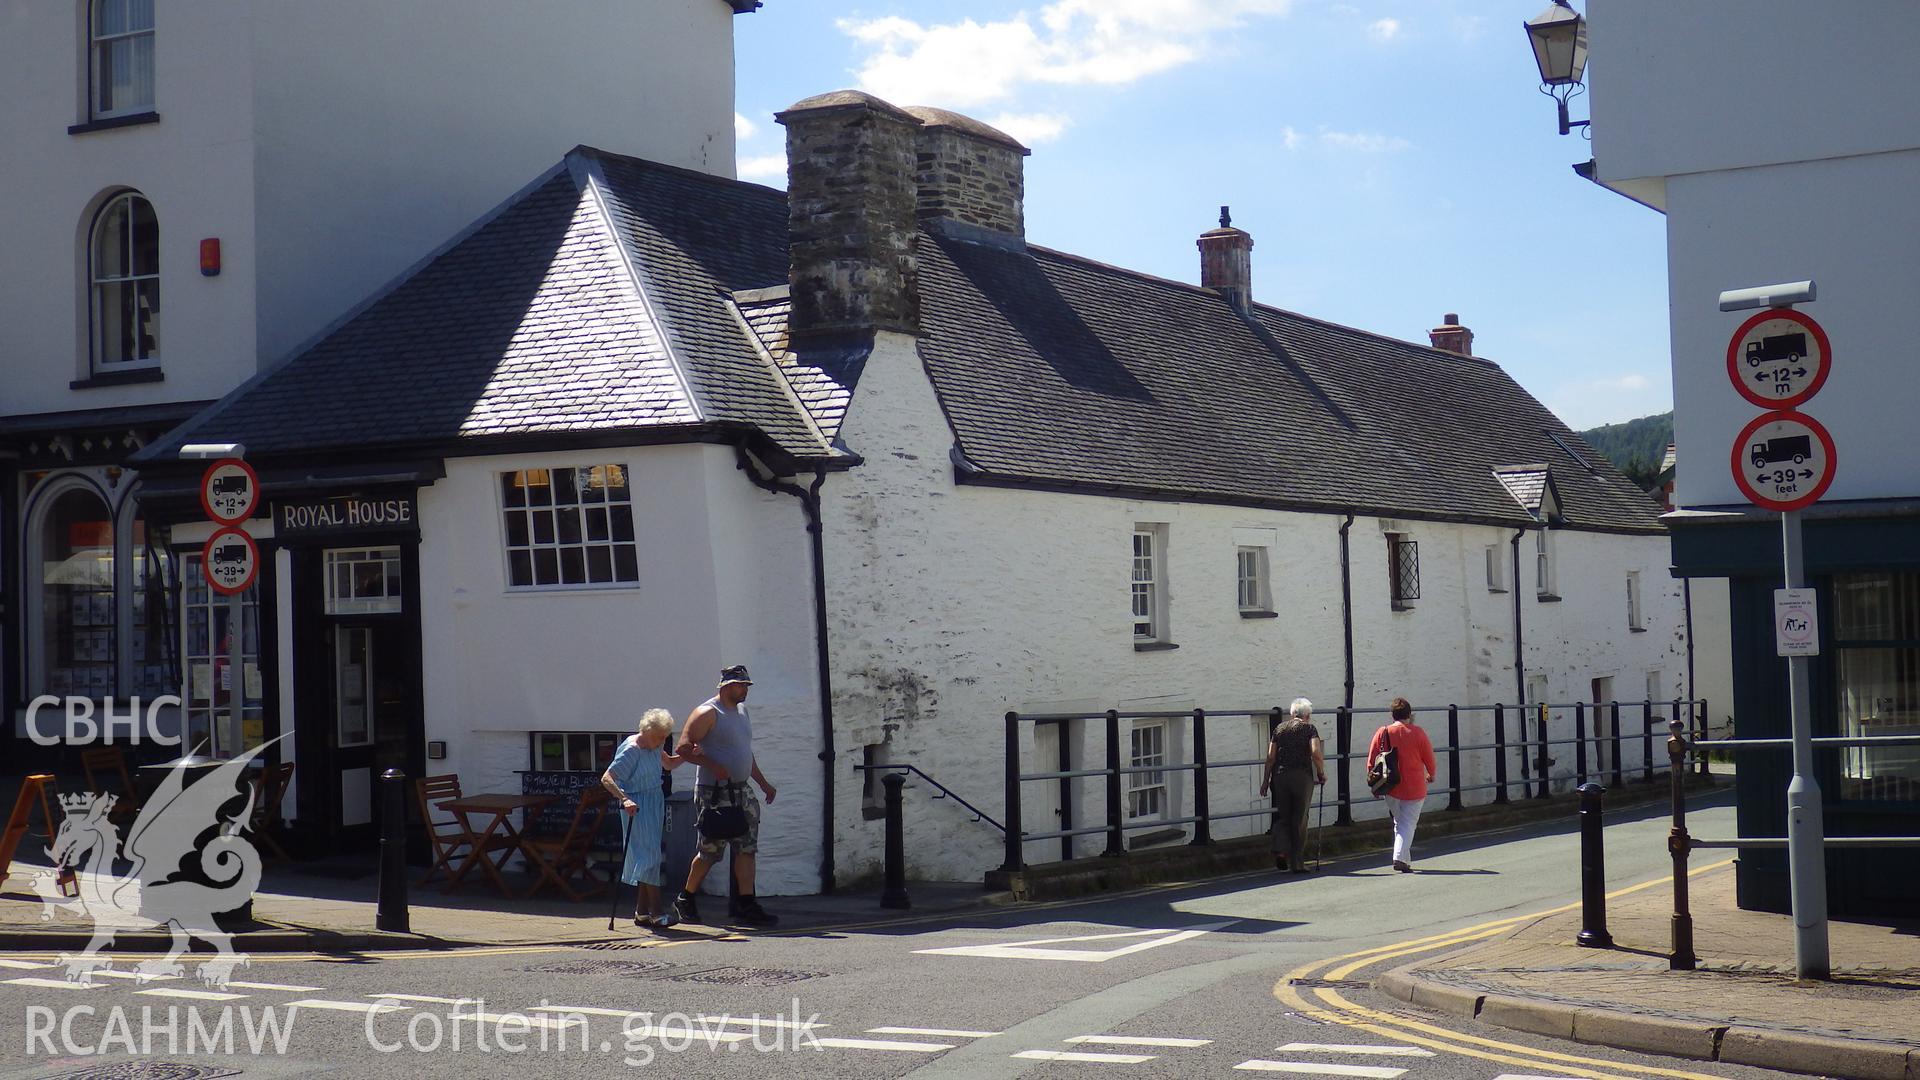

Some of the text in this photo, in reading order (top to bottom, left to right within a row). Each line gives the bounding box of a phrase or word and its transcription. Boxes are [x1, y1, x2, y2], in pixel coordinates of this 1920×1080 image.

[1772, 368, 1790, 382] 12
[1775, 383, 1790, 393] m
[1773, 469, 1796, 484] 39
[1775, 483, 1798, 494] feet
[225, 498, 236, 508] 12
[284, 500, 411, 529] ROYAL HOUSE
[223, 567, 236, 576] 39
[224, 576, 237, 584] feet
